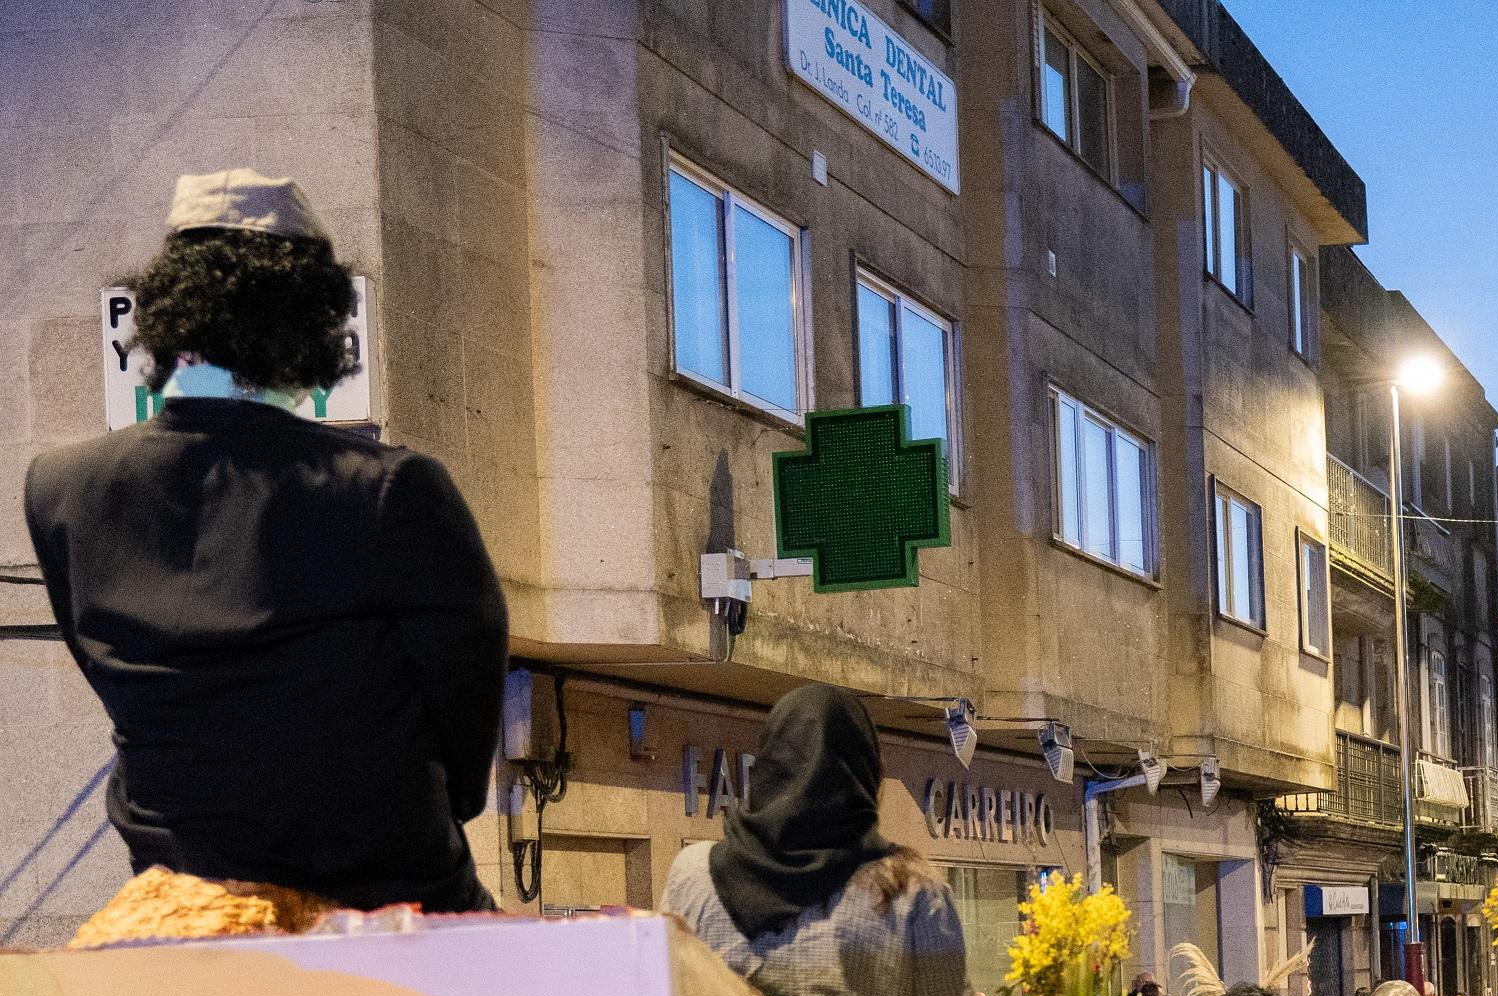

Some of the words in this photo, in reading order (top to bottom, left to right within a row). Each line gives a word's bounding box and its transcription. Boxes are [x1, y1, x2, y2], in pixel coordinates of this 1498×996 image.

[824, 26, 874, 88] Santa
[880, 68, 927, 133] Teresa
[885, 35, 946, 113] DENTAL
[884, 114, 899, 141] 582
[923, 776, 1055, 849] CARREIRO
